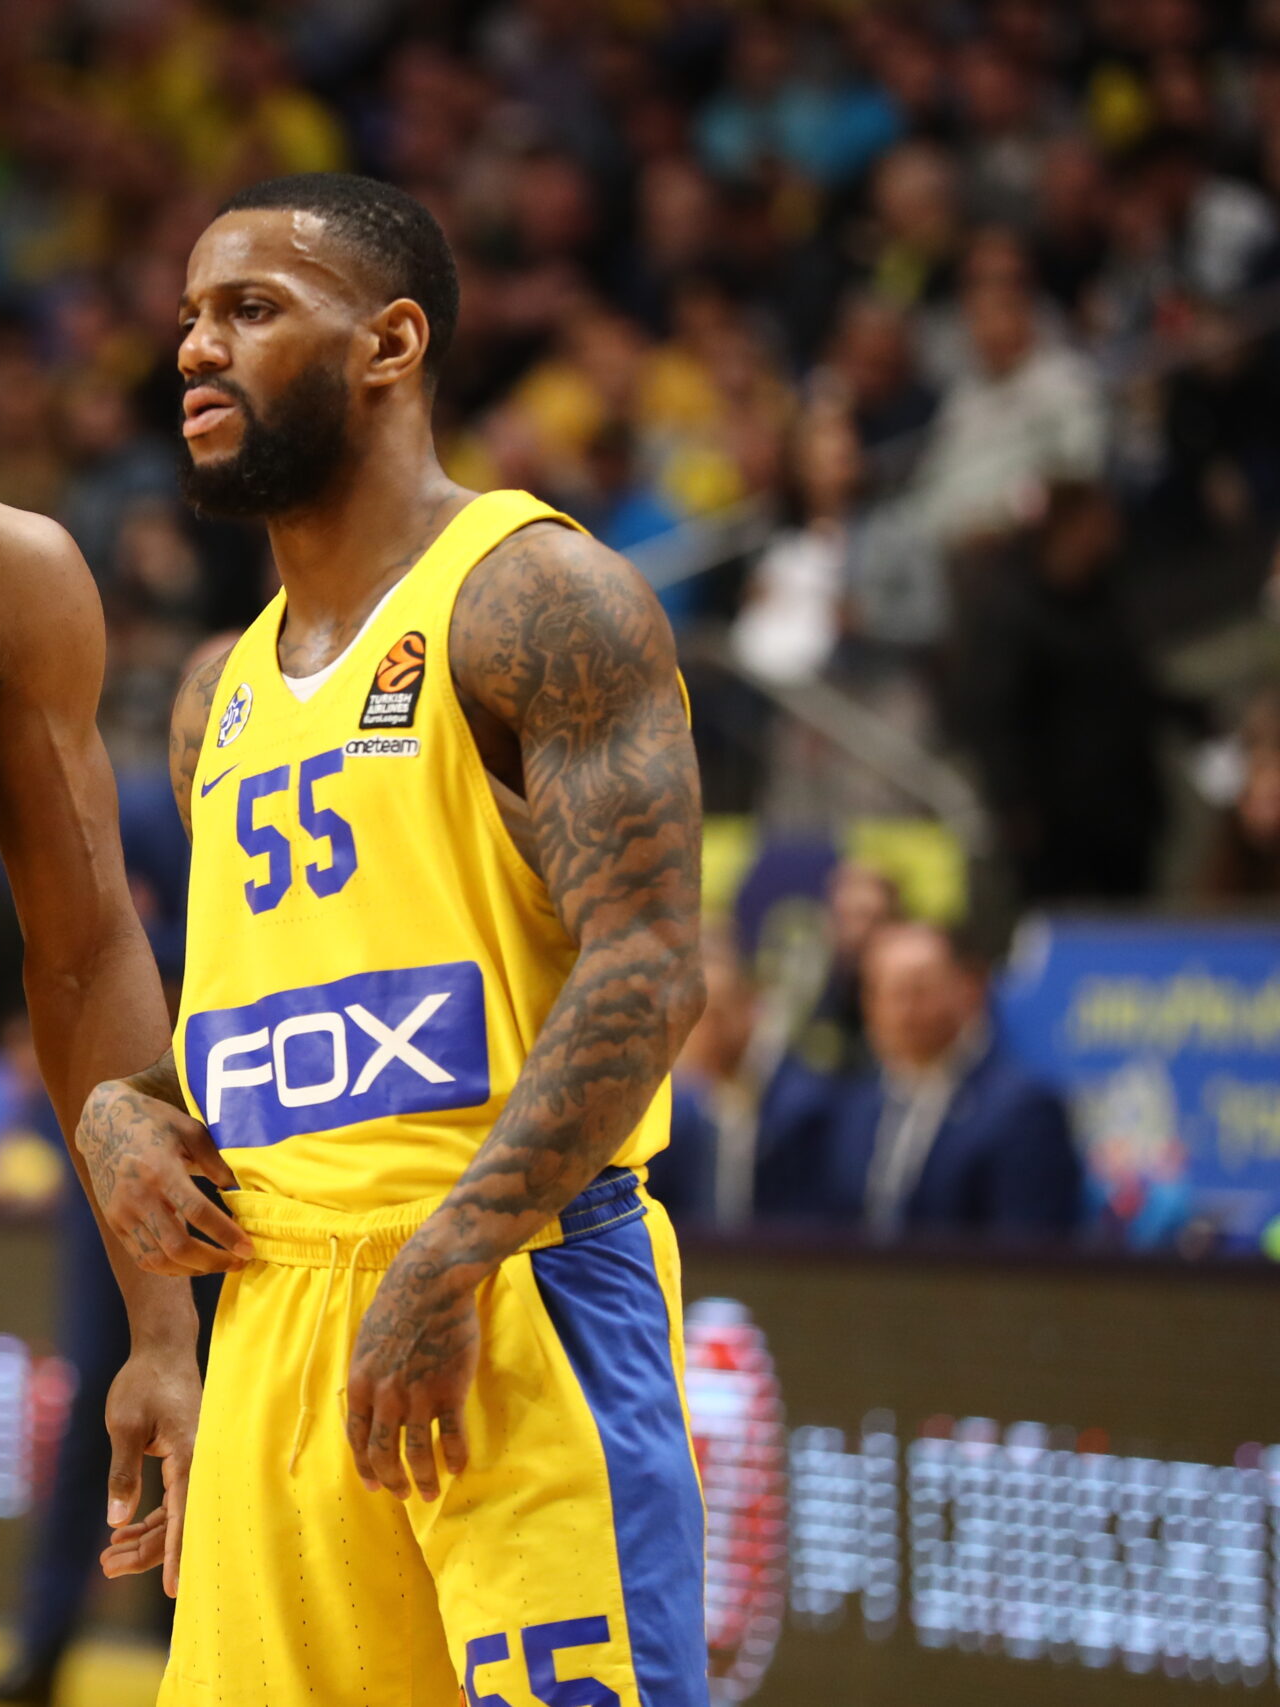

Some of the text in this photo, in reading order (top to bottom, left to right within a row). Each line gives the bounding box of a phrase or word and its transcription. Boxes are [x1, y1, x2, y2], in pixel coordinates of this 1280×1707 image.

[369, 692, 413, 704] TURKISH
[366, 703, 410, 714] AIRLINES
[345, 737, 418, 754] oneteam
[236, 748, 358, 915] 55
[206, 992, 457, 1126] FOX
